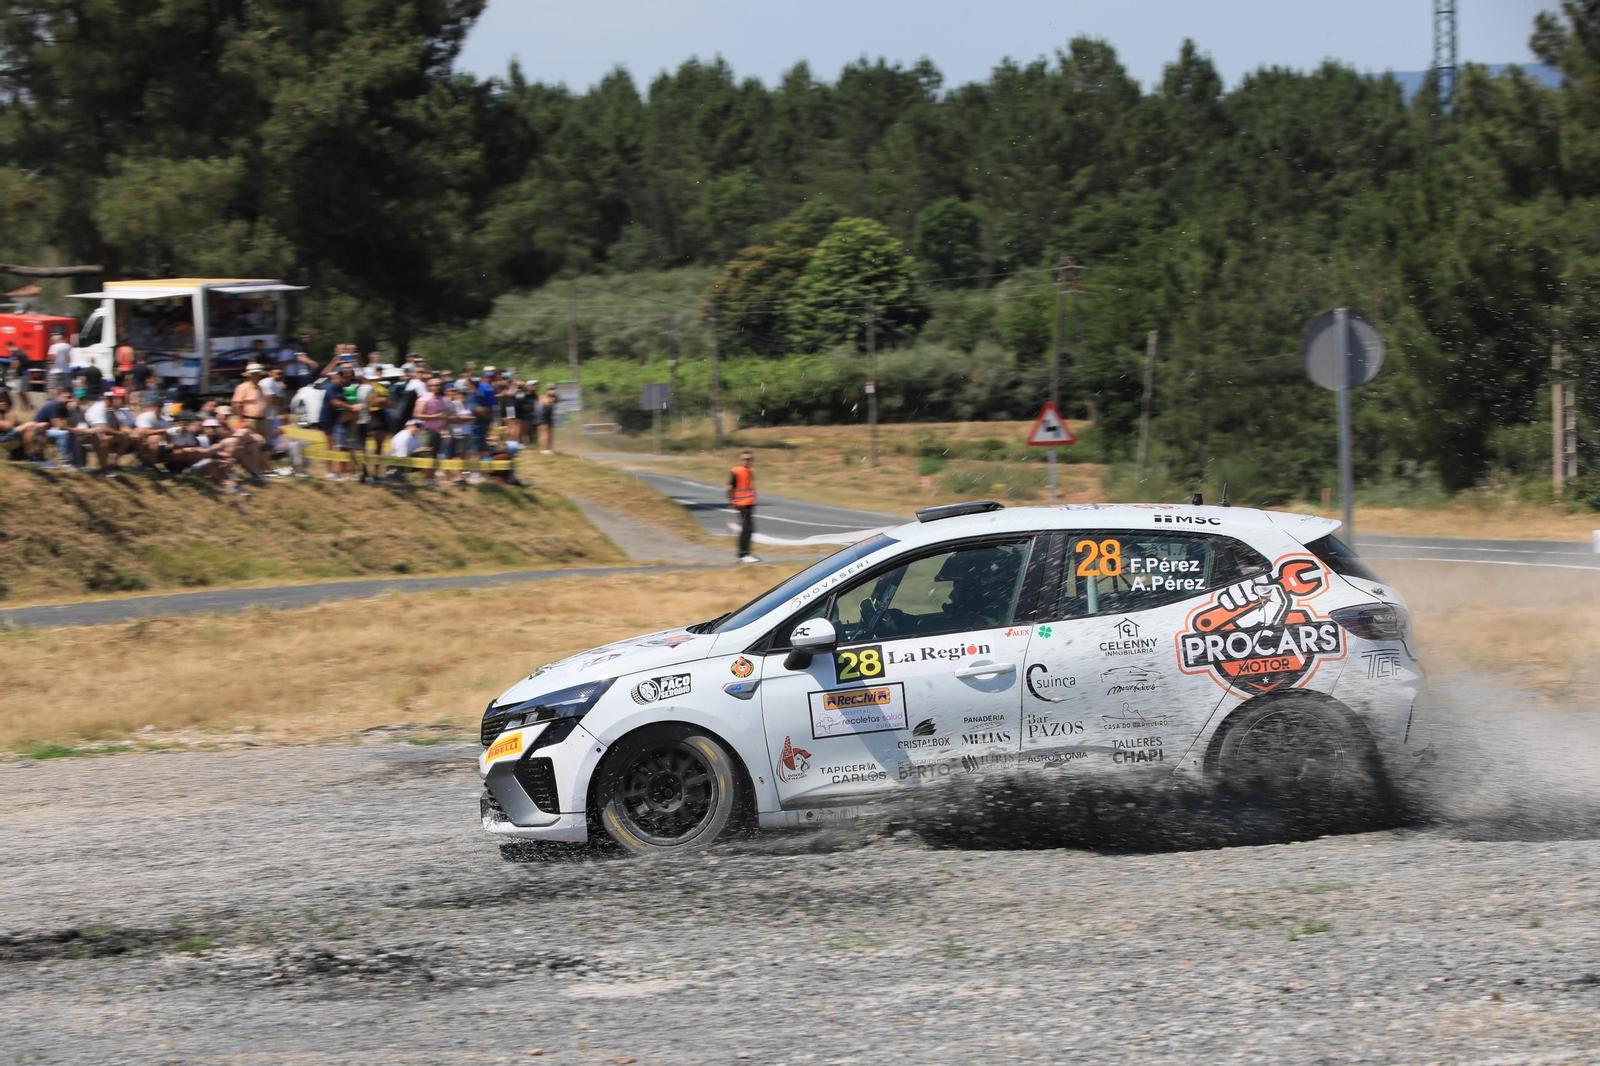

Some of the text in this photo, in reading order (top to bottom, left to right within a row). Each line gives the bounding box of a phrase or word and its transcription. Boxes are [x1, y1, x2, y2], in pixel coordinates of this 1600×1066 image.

[1176, 516, 1221, 525] MSC
[1075, 539, 1122, 577] 28
[1130, 557, 1200, 573] F.Pérez
[803, 560, 870, 600] NOVASERI
[1131, 575, 1206, 591] A.Pérez
[1099, 638, 1158, 651] CELENNY
[1184, 624, 1337, 664] PROCARS
[888, 651, 915, 664] La
[1105, 648, 1154, 657] INMOBILIARIA
[838, 649, 882, 680] 28
[1238, 658, 1290, 673] MOTOR
[660, 676, 690, 691] PACO
[660, 686, 690, 699] SERODIO
[837, 692, 877, 705] Recalvi
[842, 712, 903, 725] recoletas salud
[963, 714, 1006, 723] PANADERIA
[1028, 714, 1049, 724] Bar
[1028, 720, 1085, 738] PAZOS
[488, 737, 519, 759] PIRELLI
[897, 737, 951, 749] CRISTALBOX
[1112, 736, 1163, 750] TALLERES
[1112, 749, 1164, 764] CHAPI
[832, 771, 887, 784] CARLOS
